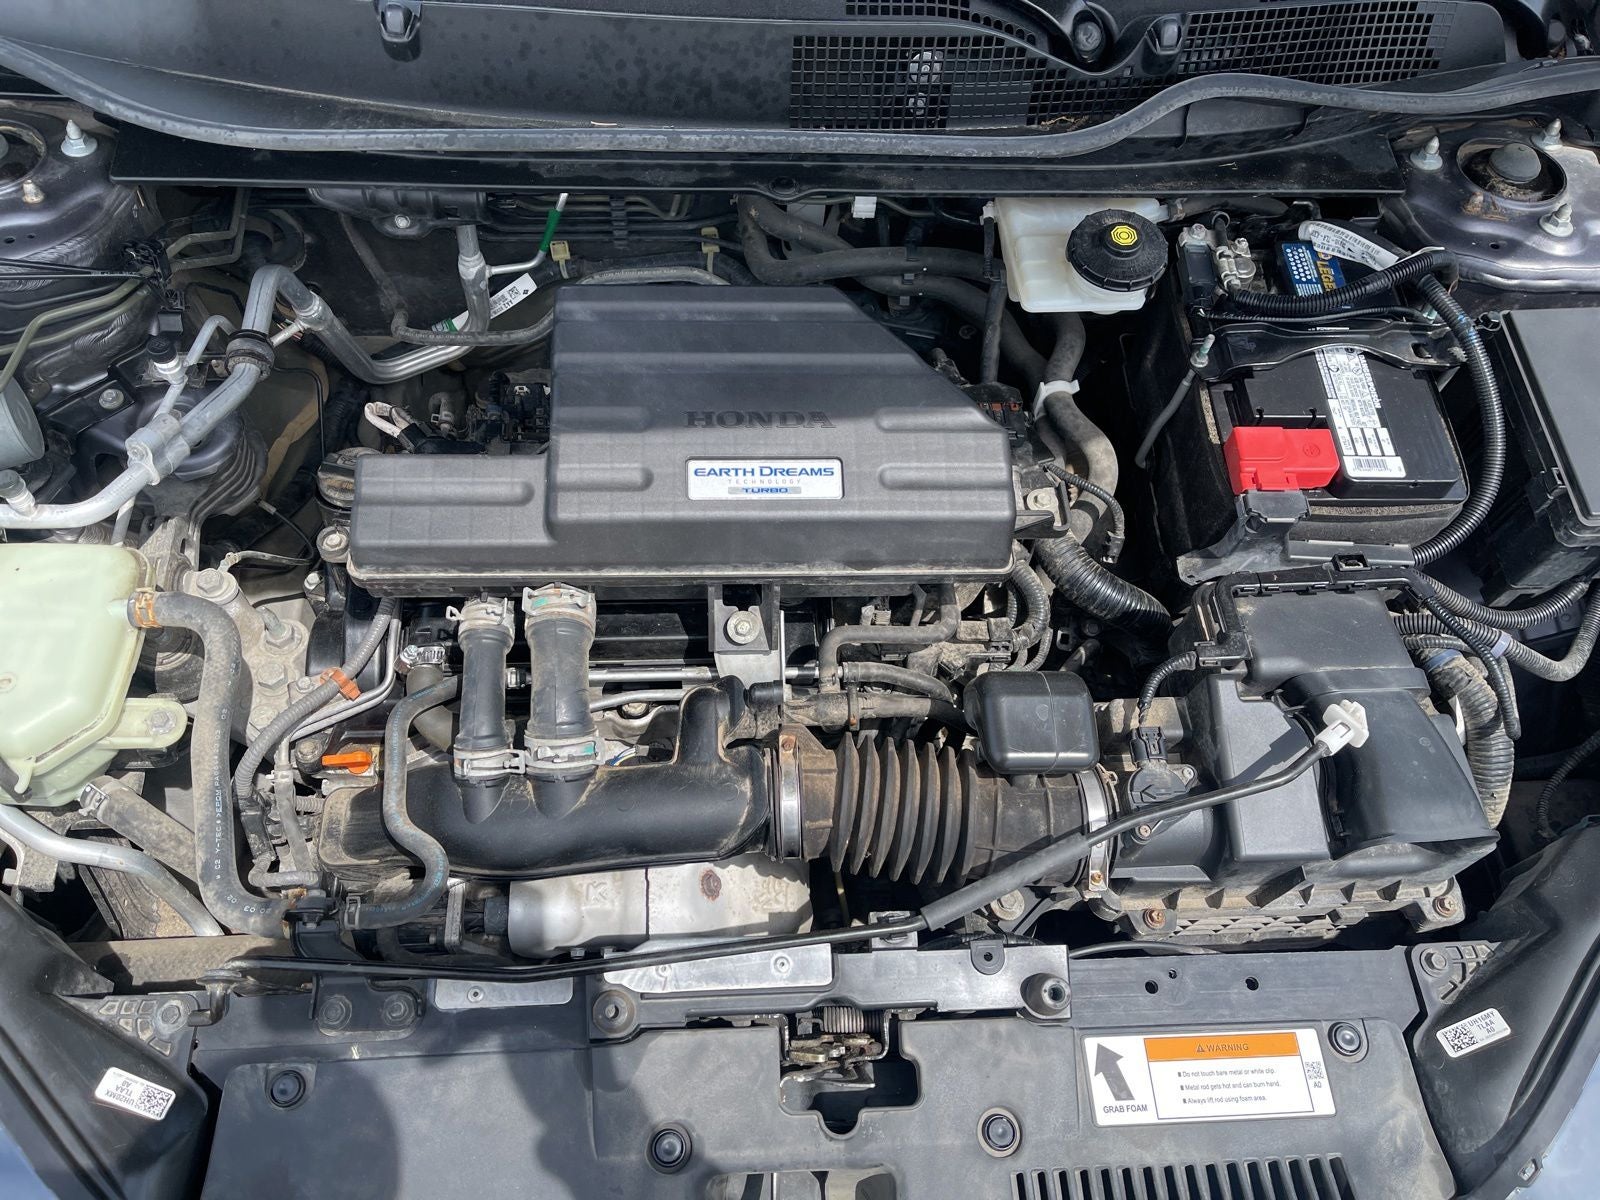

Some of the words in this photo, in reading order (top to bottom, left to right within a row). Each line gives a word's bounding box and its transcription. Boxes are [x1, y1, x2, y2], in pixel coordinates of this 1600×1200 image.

[1316, 261, 1336, 292] LEGE
[681, 411, 837, 429] HONDA
[693, 467, 756, 477] EARTH
[758, 466, 835, 477] DREAMS
[1206, 1043, 1249, 1052] WARNING
[1211, 1083, 1222, 1091] gets
[1225, 1096, 1239, 1104] using
[1103, 1105, 1125, 1114] GRAB
[1126, 1104, 1148, 1113] FOAM
